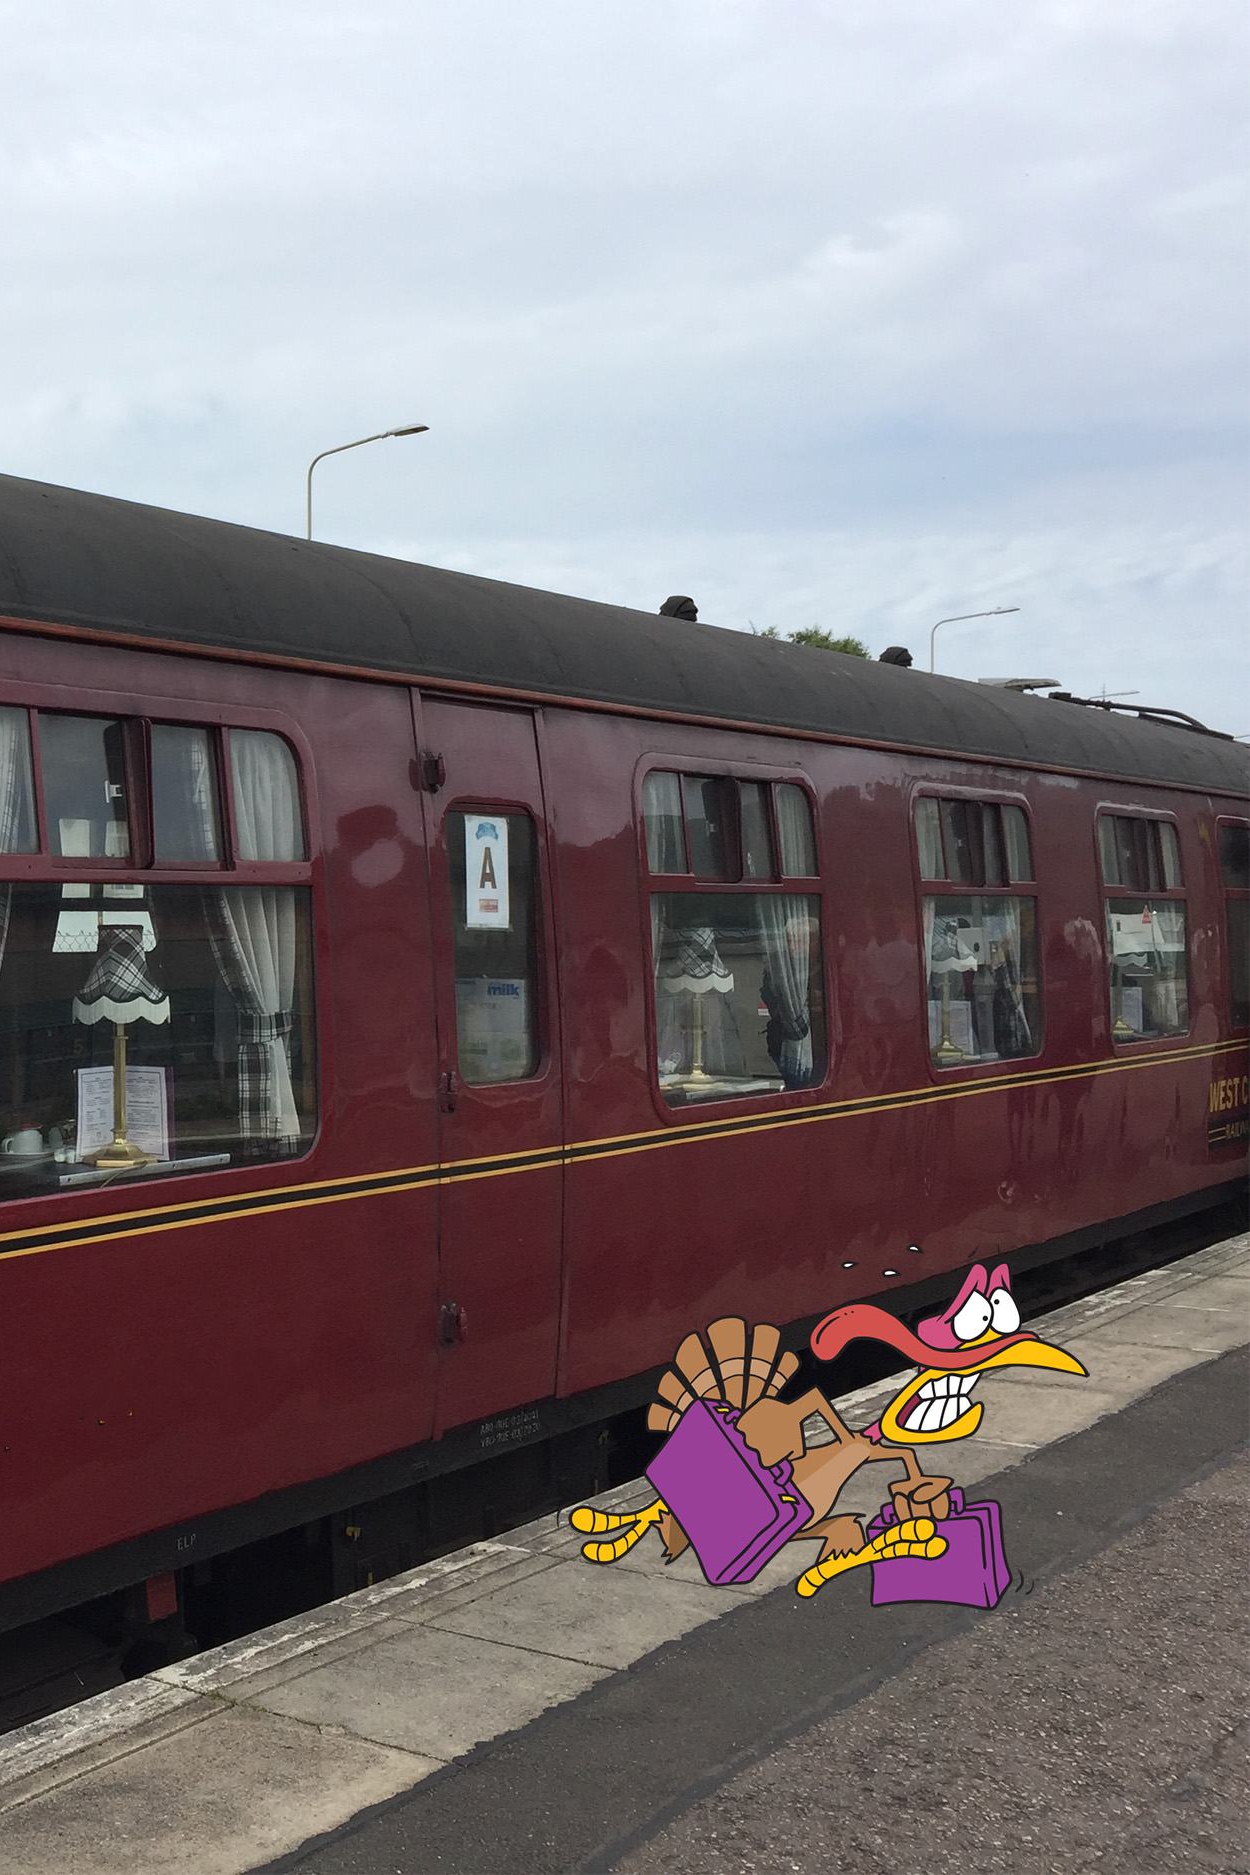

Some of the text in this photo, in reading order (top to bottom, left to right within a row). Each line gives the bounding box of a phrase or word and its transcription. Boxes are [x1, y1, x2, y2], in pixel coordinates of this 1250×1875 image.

[479, 846, 498, 889] A
[487, 983, 520, 997] milk
[1209, 1077, 1240, 1112] WEST
